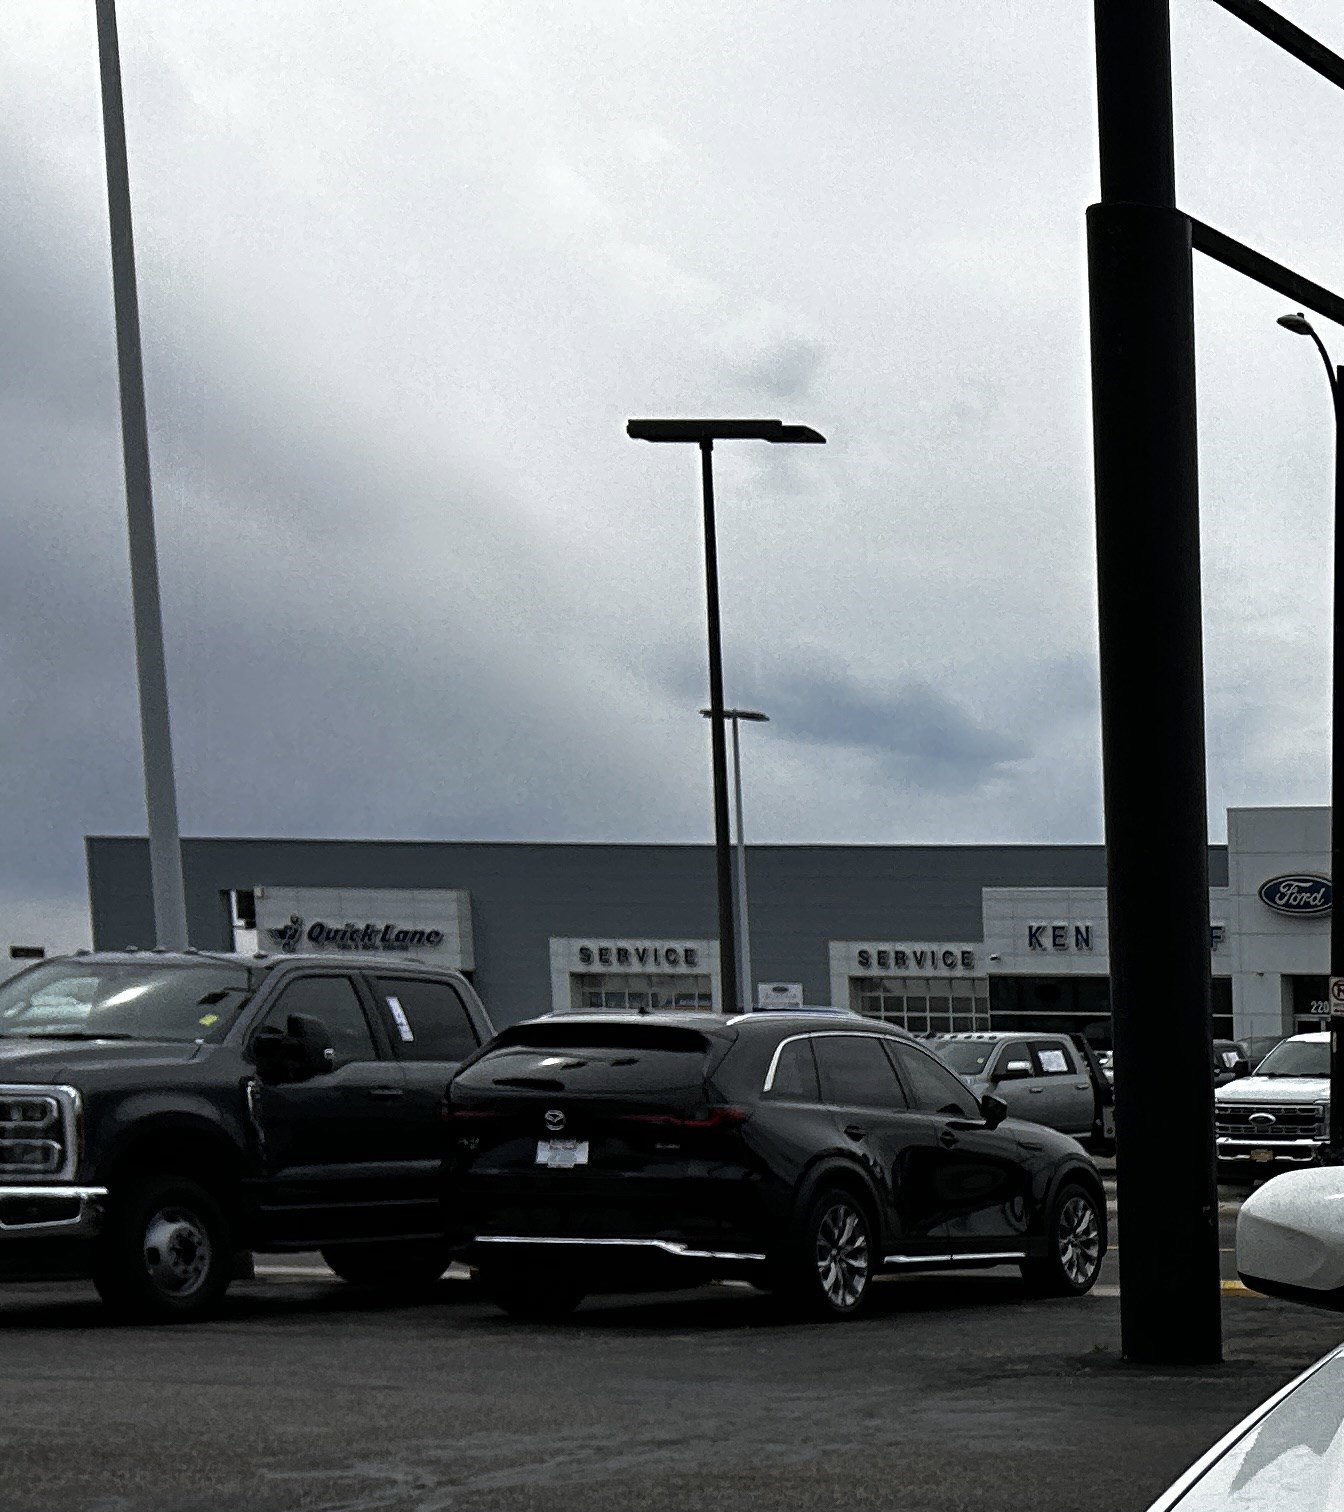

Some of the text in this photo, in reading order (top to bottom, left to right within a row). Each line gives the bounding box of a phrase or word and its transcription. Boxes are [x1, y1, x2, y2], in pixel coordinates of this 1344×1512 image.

[1274, 880, 1326, 906] Ford
[307, 921, 444, 945] Quick Lane
[1028, 925, 1092, 949] KEN
[578, 946, 697, 967] SERVICE
[857, 949, 975, 969] SERVICE
